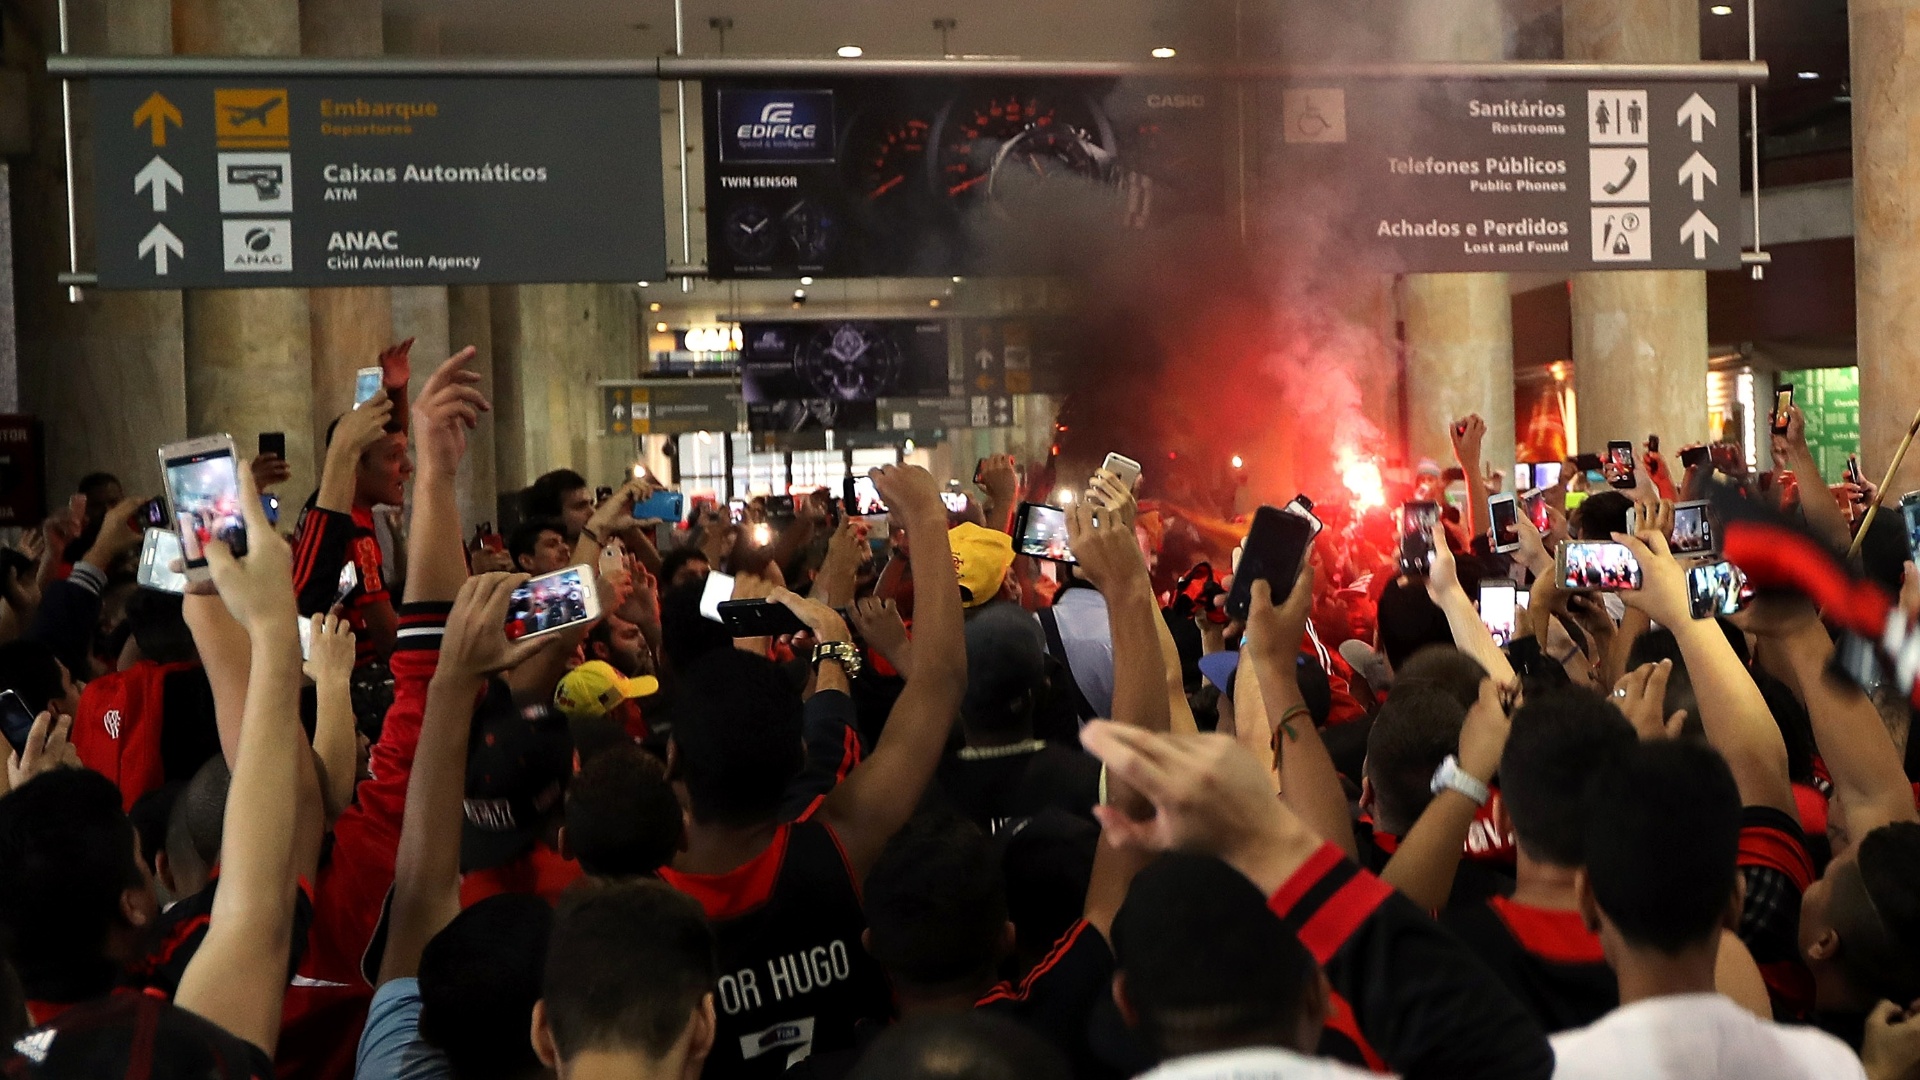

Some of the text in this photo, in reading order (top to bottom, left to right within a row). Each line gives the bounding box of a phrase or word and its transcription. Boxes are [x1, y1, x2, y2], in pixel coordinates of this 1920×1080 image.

[1146, 94, 1204, 108] CASIO
[1470, 99, 1566, 118] Sanitários
[320, 99, 438, 121] Embarque
[320, 123, 412, 136] Departures
[737, 123, 816, 138] EDIFICE
[1491, 122, 1566, 135] Restrooms
[1388, 156, 1566, 174] Telefones Públicos
[324, 163, 547, 183] Caixas Automáticos
[720, 175, 798, 188] TWIN SENSOR
[1470, 180, 1566, 191] Public Phones
[324, 188, 358, 201] ATM
[1377, 218, 1568, 237] Achados e Perdidos
[328, 231, 398, 250] ANAC
[1464, 241, 1569, 253] Lost and Found
[235, 254, 283, 265] ANAC
[327, 255, 481, 270] Civil Aviation Agency
[768, 939, 850, 1001] HUGO
